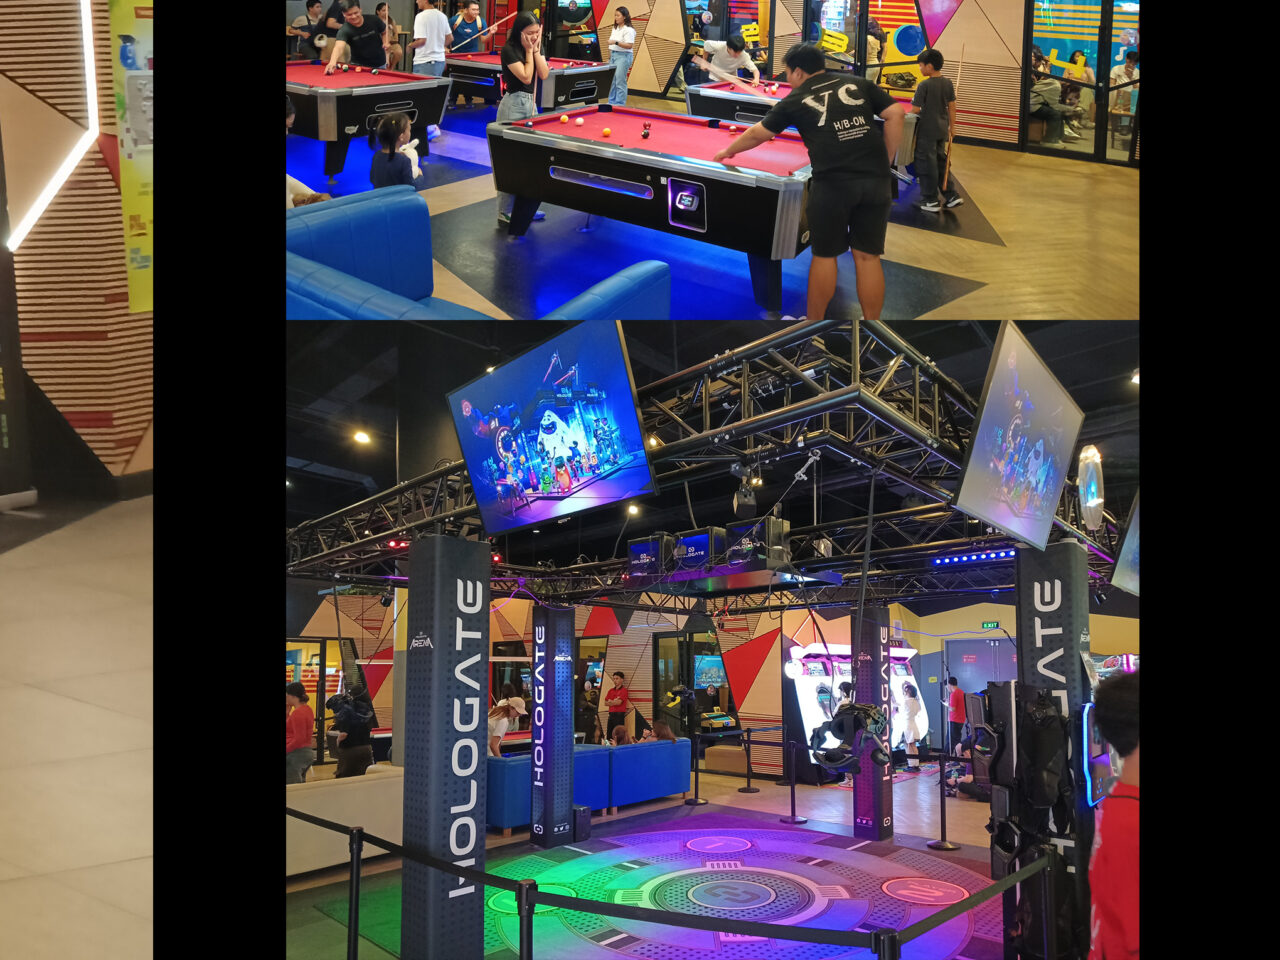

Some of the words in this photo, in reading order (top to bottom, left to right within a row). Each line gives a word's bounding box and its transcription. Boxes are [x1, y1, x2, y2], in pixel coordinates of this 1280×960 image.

[833, 116, 866, 130] H/B-ON
[410, 637, 434, 650] ARENA
[448, 578, 483, 899] HOLOGATE
[534, 625, 545, 788] HOLOGATE
